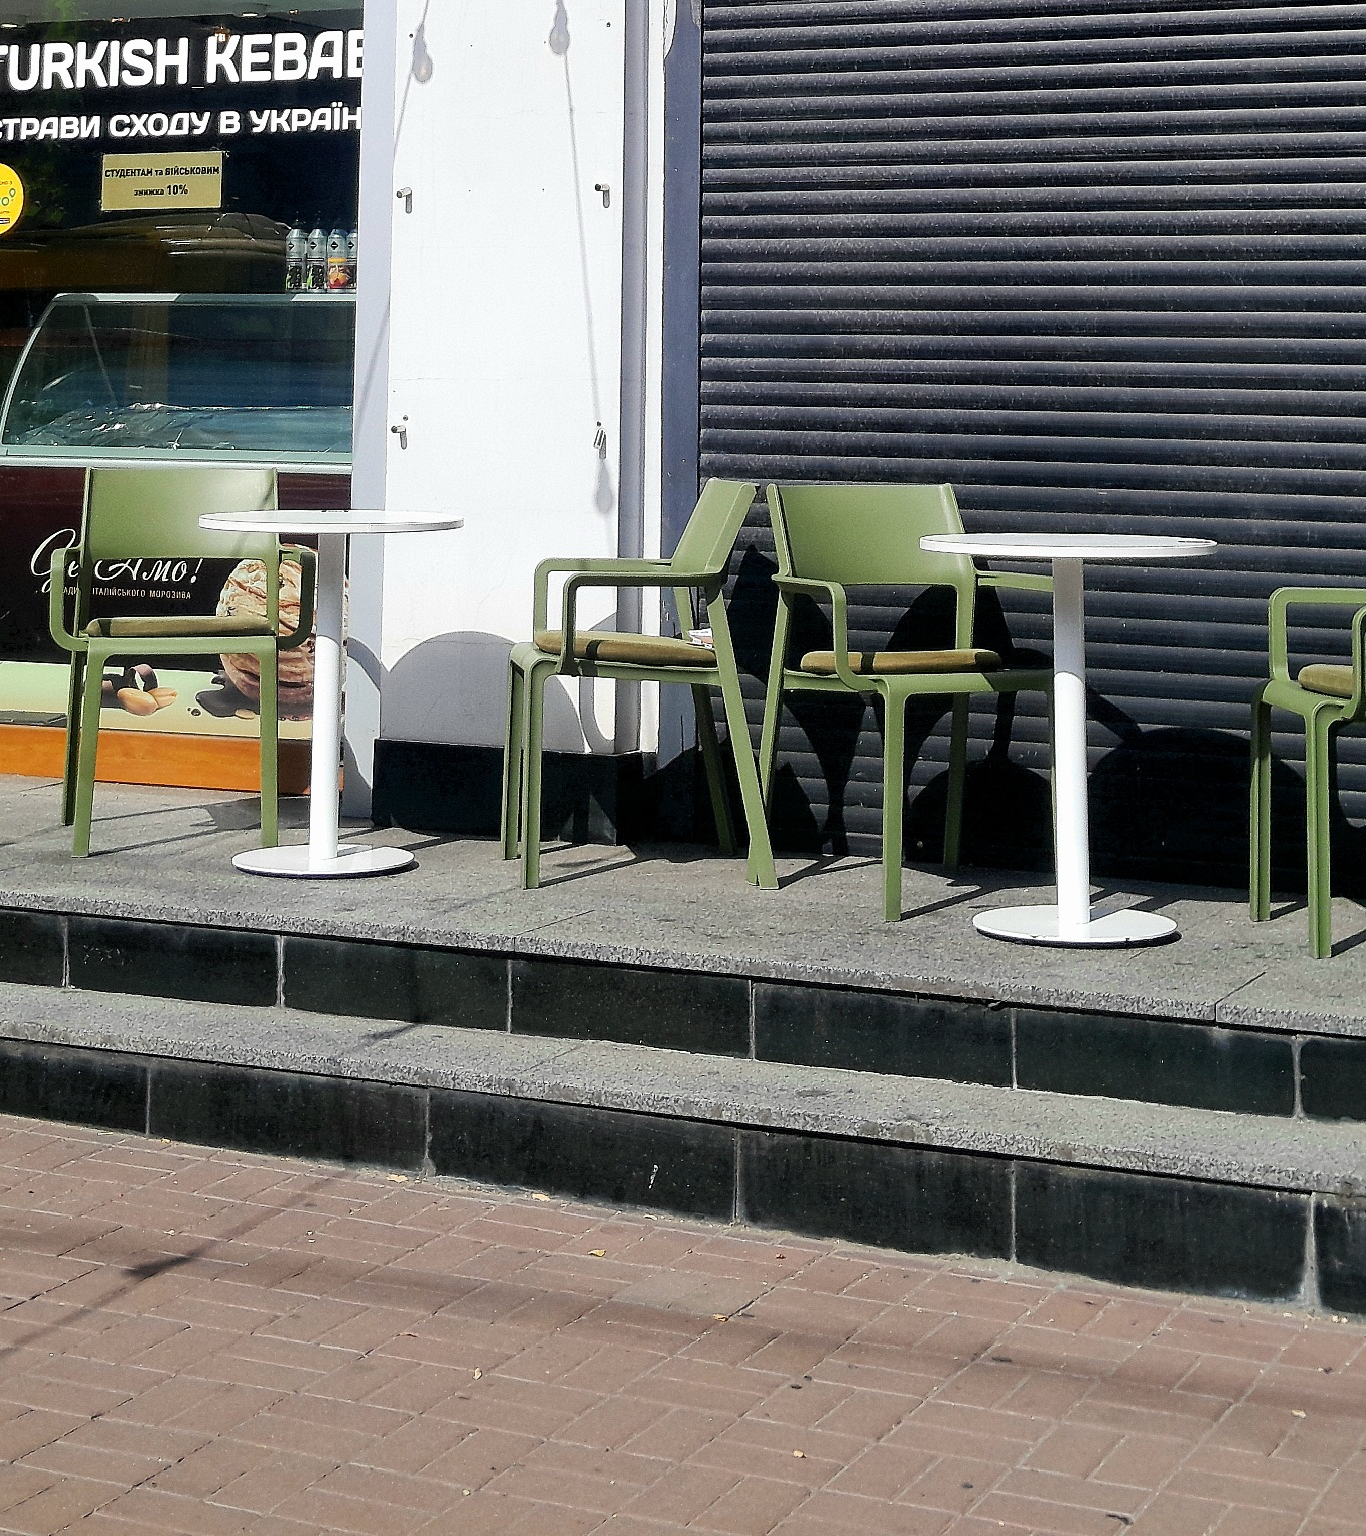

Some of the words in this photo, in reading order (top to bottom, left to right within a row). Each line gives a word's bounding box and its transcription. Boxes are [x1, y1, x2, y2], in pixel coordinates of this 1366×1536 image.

[206, 29, 364, 83] KEBAB
[109, 111, 211, 138] СХОДУ
[219, 111, 241, 134] В
[249, 101, 362, 133] УКРАЇН
[104, 168, 153, 178] СТУДЕНТАМ
[165, 166, 220, 176] ВІЙСЬКОВИМ
[167, 184, 189, 196] 10%
[149, 589, 191, 600] МОРОЗИВА
